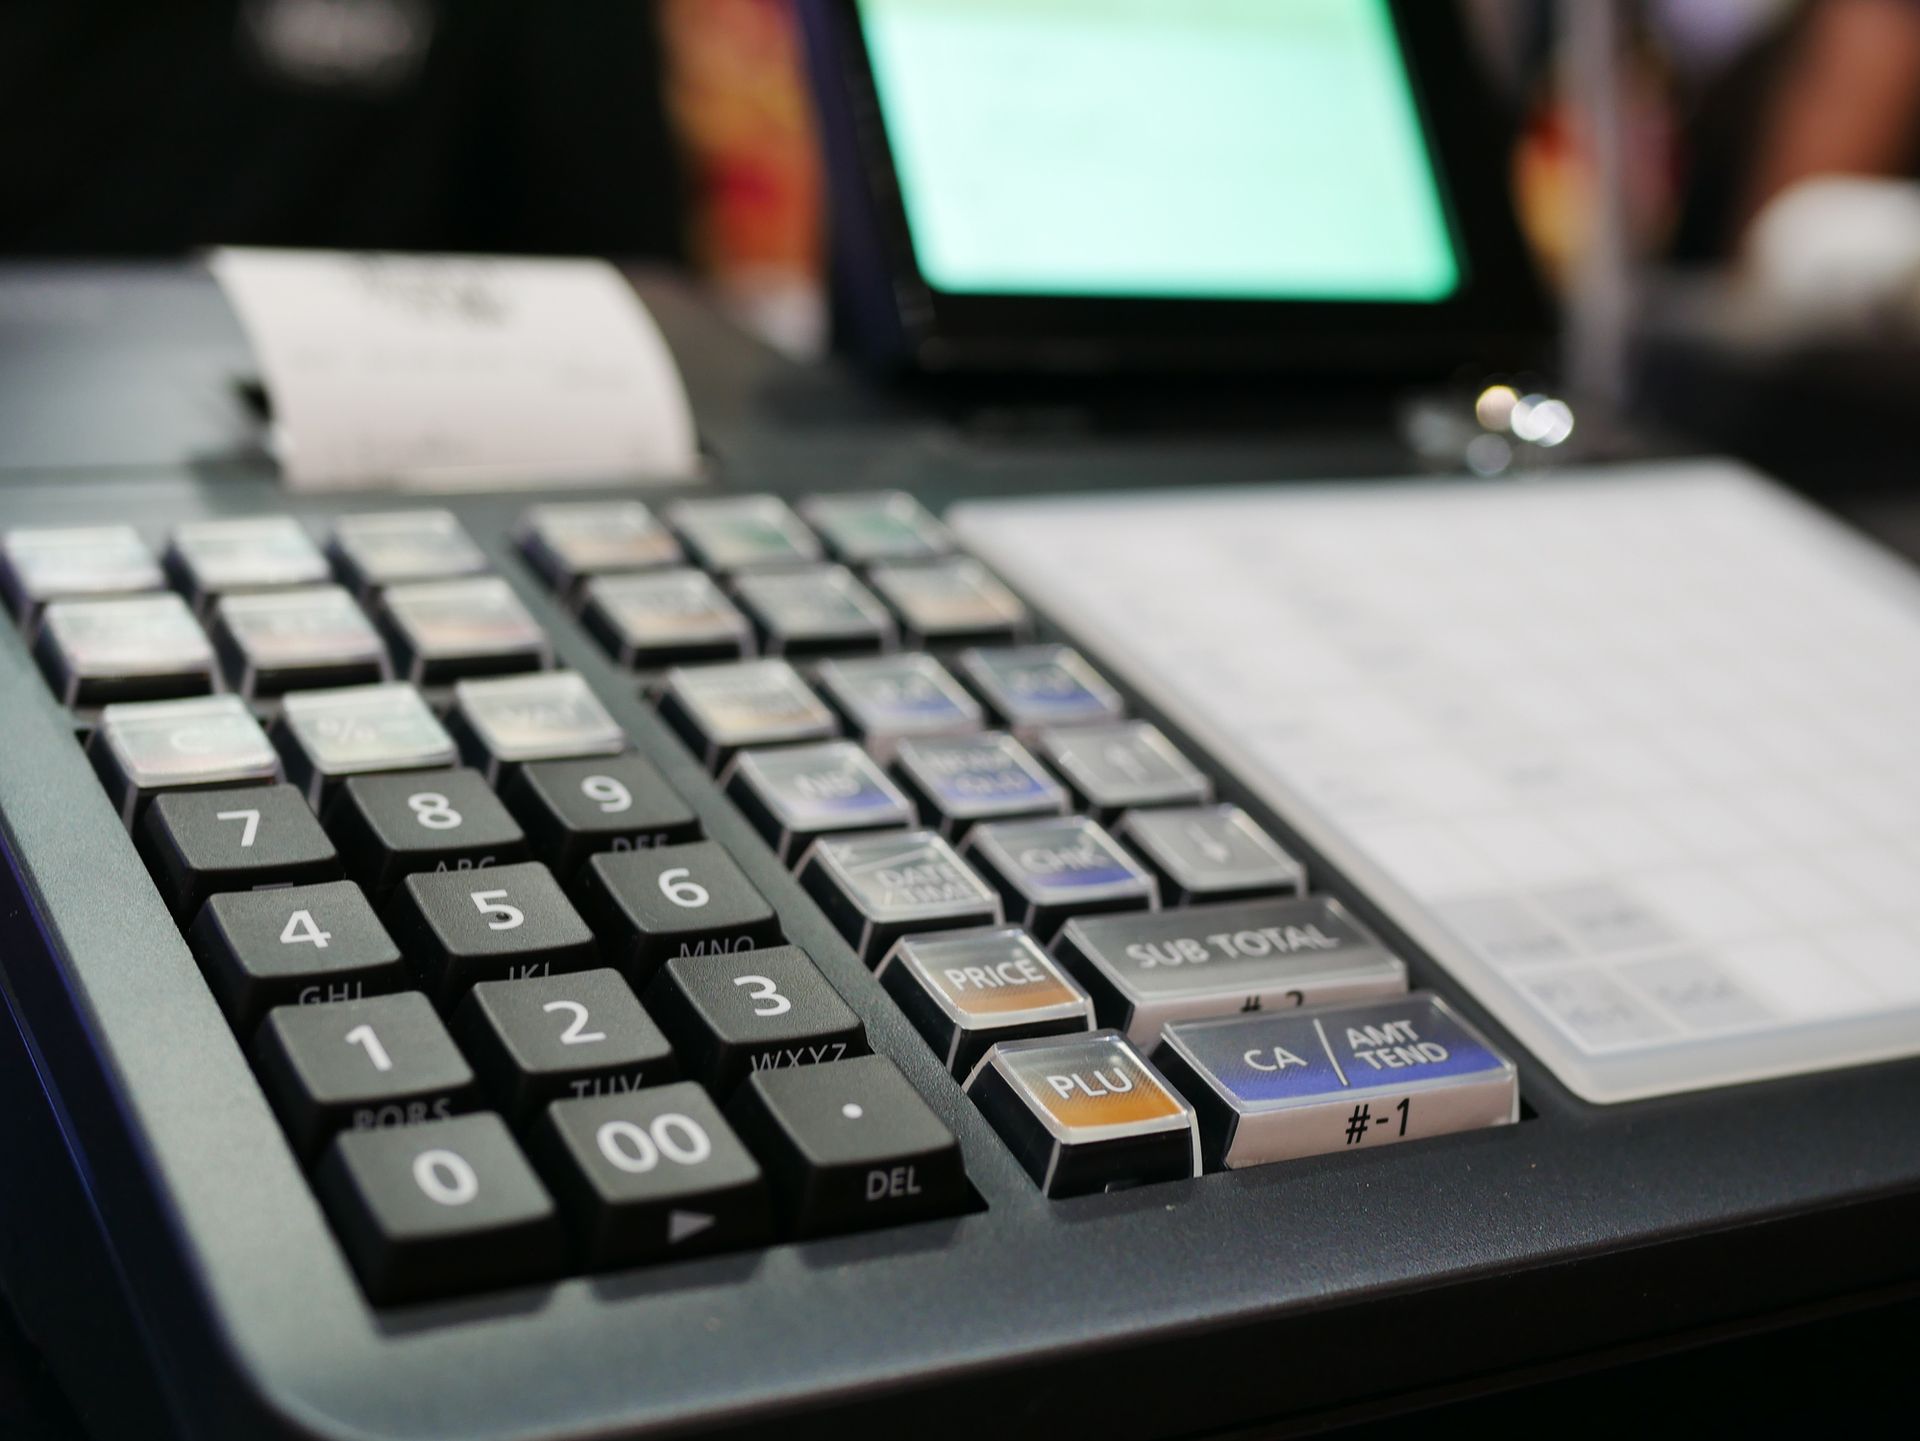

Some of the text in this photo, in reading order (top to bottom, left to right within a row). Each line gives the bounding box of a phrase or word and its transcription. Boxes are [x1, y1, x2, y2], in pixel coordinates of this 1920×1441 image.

[408, 792, 462, 829] 8
[581, 776, 632, 812] 9
[217, 809, 260, 846] 7
[658, 868, 710, 907] 6
[470, 889, 525, 930] 5
[280, 910, 331, 947] 4
[1125, 924, 1340, 968] SUB TOTAL
[943, 957, 1047, 990] PRICE
[733, 975, 792, 1016] 3
[543, 1000, 606, 1045] 2
[1345, 1020, 1420, 1049] AMT
[345, 1024, 393, 1071] 1
[751, 1042, 848, 1072] WXYZ
[1243, 1045, 1308, 1072] CA
[1354, 1042, 1449, 1070] TEND
[1045, 1067, 1135, 1101] PLU
[1345, 1097, 1411, 1145] #-1
[596, 1112, 712, 1173] 00
[413, 1148, 478, 1205] 0
[865, 1166, 922, 1199] DEL
